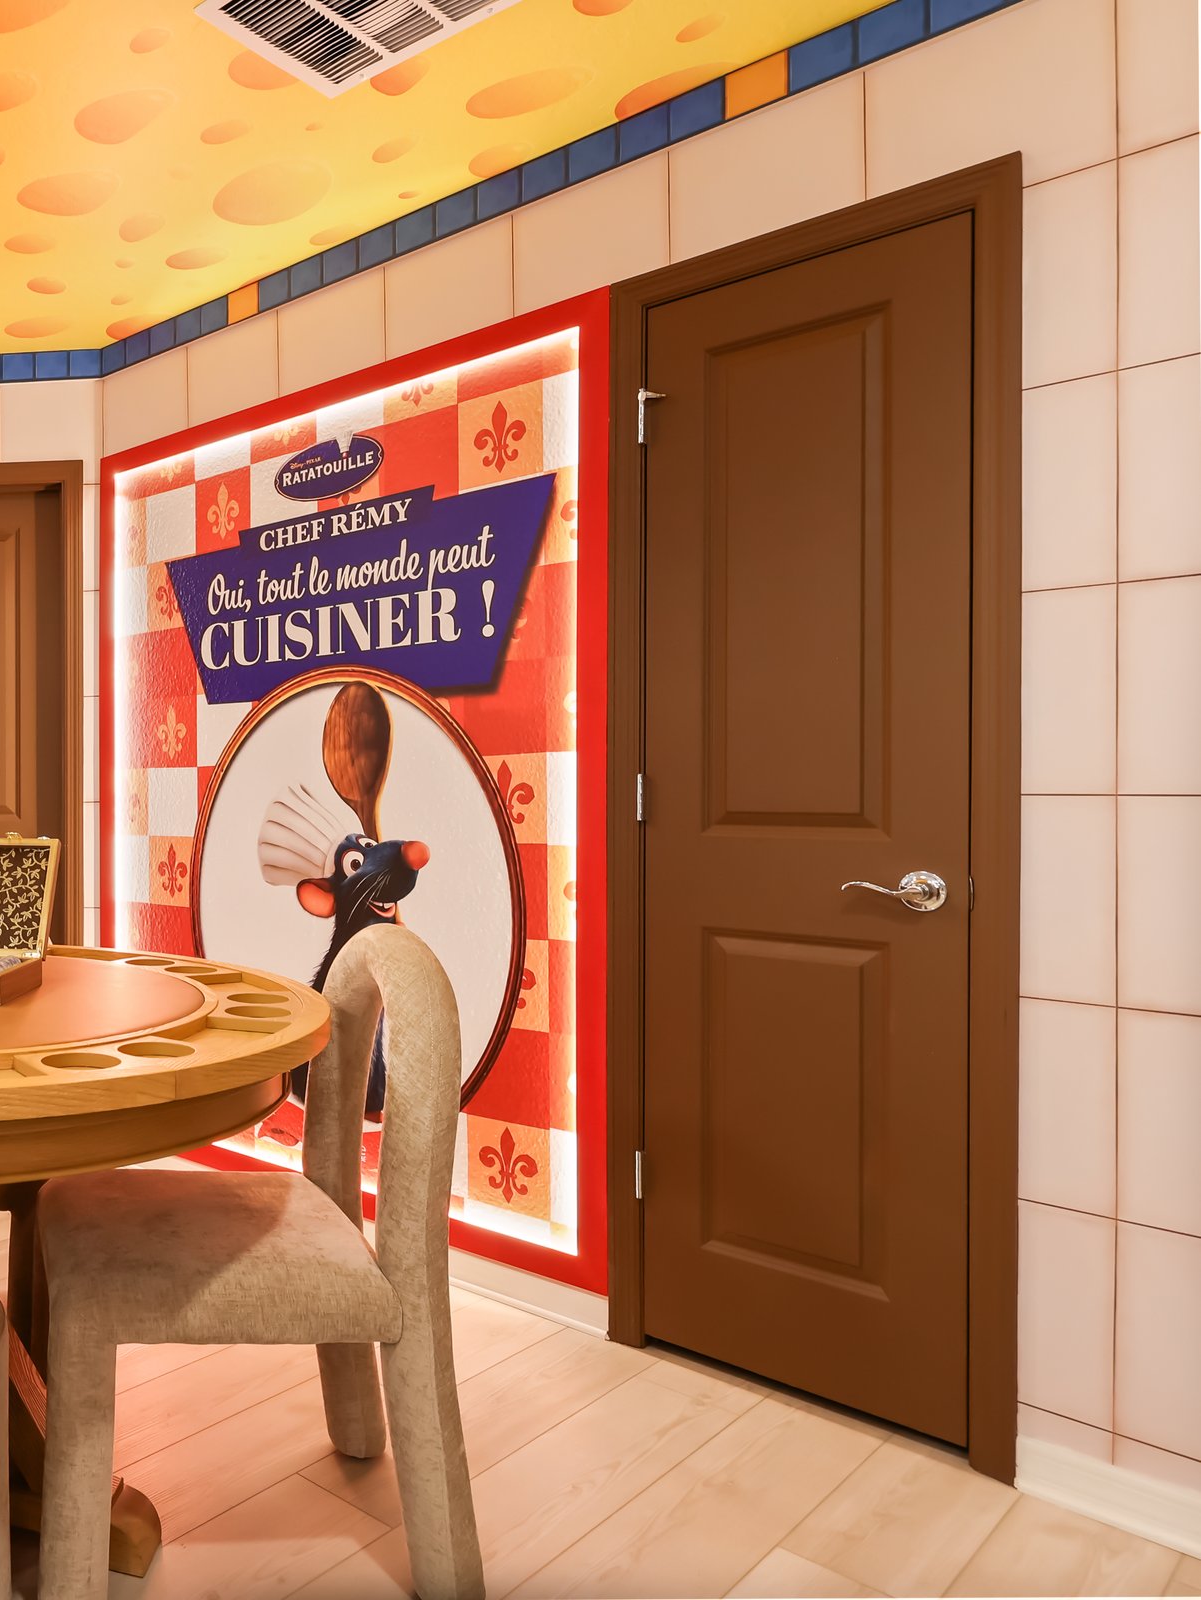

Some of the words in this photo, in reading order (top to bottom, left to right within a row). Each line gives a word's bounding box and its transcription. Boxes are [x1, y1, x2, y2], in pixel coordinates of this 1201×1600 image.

[282, 451, 374, 487] RATATOUILLE
[259, 517, 325, 552] CHEF
[330, 497, 412, 539] RÉMY
[207, 574, 251, 616] Oui,
[257, 564, 304, 606] tout
[309, 556, 332, 596] le
[336, 538, 424, 591] monde
[426, 525, 495, 589] peut
[200, 585, 461, 670] CUISINER
[481, 580, 495, 638] !
